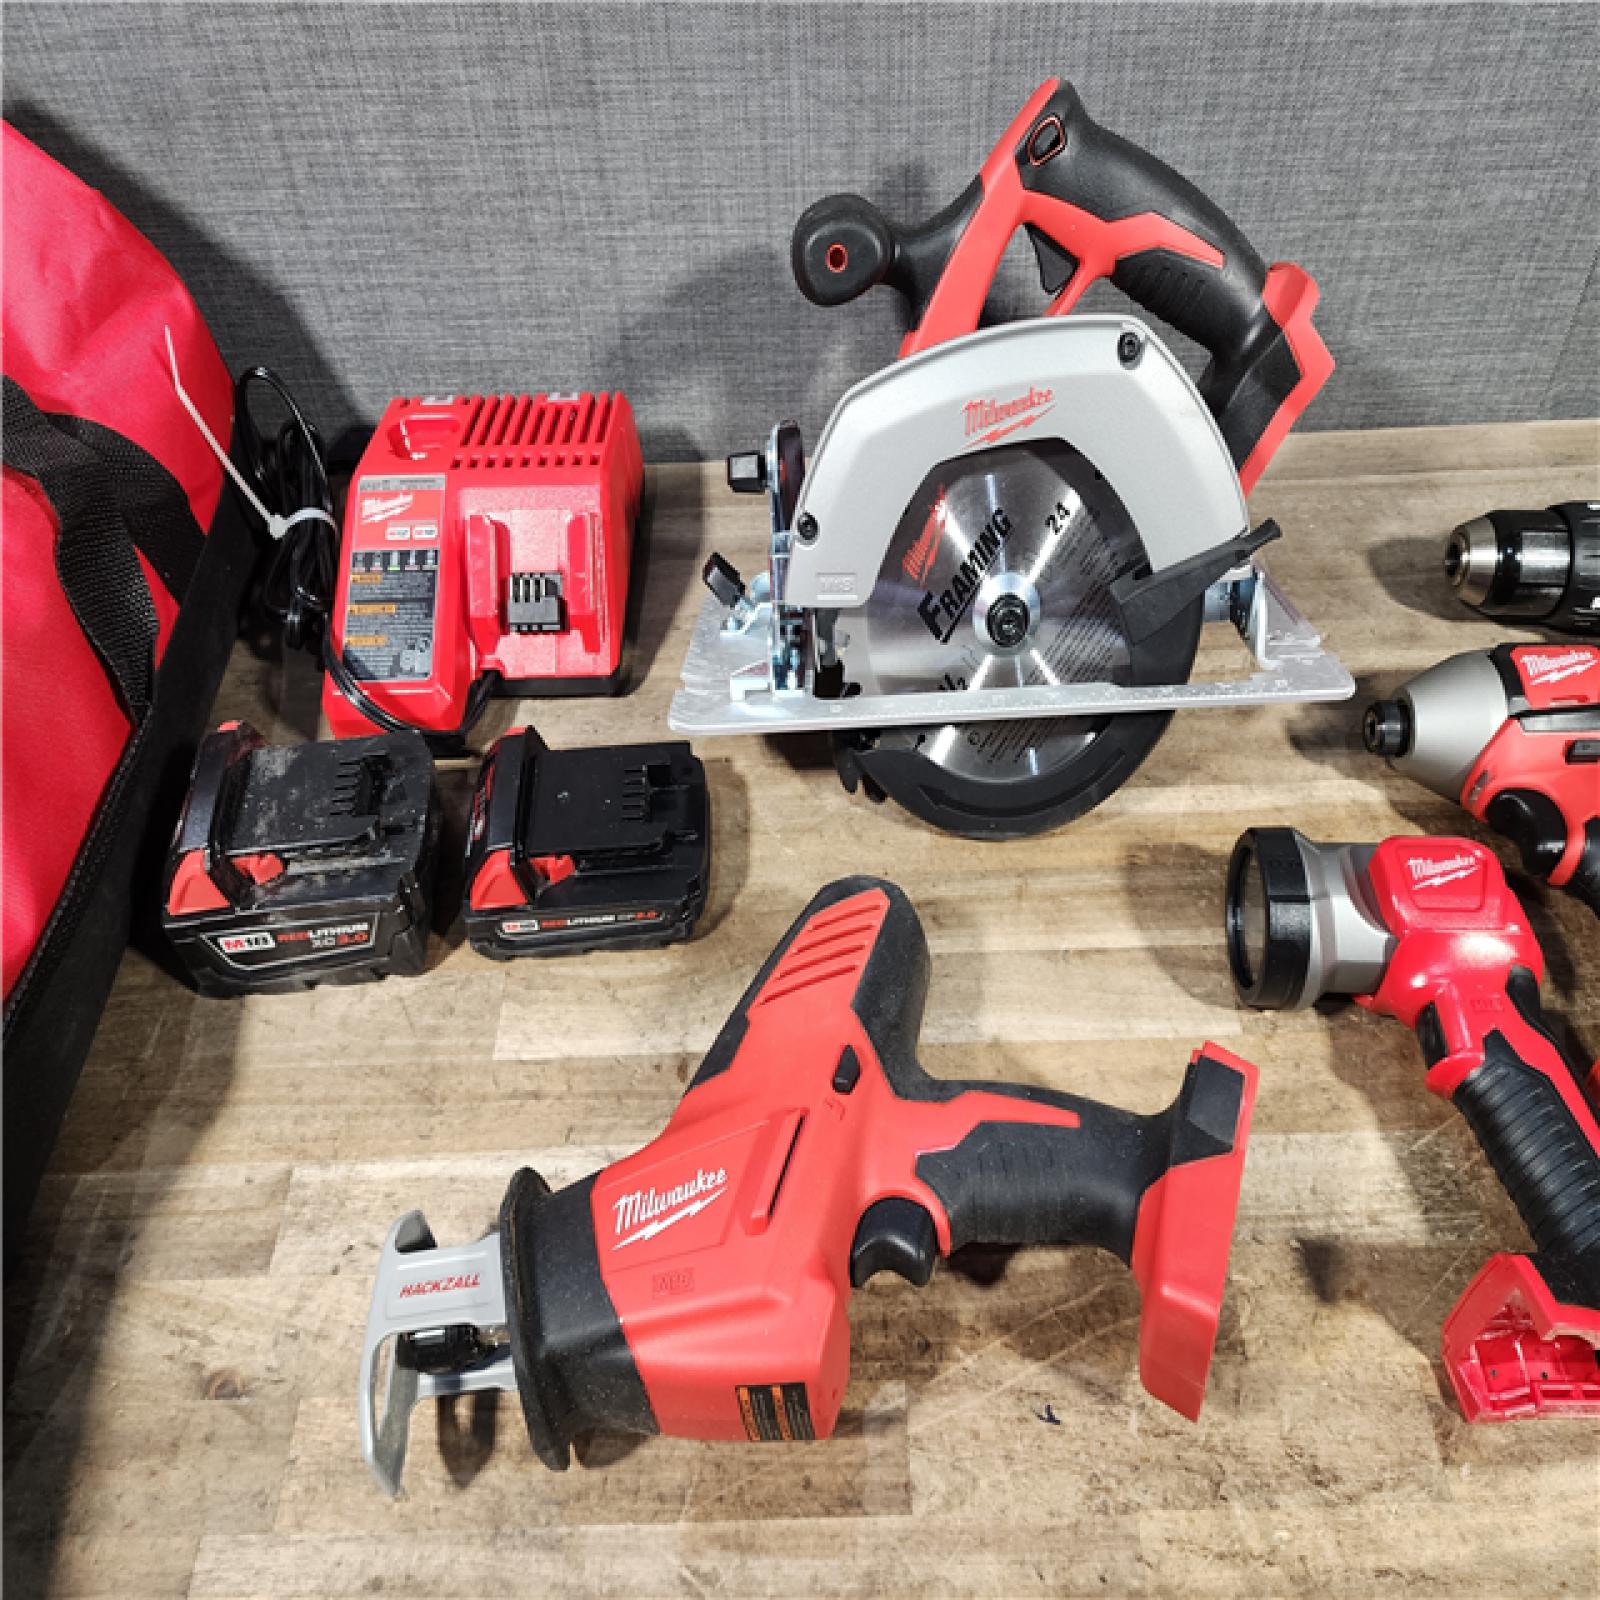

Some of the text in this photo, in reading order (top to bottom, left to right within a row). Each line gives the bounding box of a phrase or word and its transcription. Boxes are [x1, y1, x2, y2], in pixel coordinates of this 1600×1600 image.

[961, 385, 1053, 436] Milwaukee
[1045, 501, 1071, 536] 24
[918, 507, 1012, 641] FRAMING
[1520, 649, 1592, 677] Milwaukee
[1406, 854, 1476, 880] Milwaukee
[223, 935, 270, 950] M18
[612, 1167, 726, 1235] Milwaukee
[399, 1272, 480, 1299] HACKZALL
